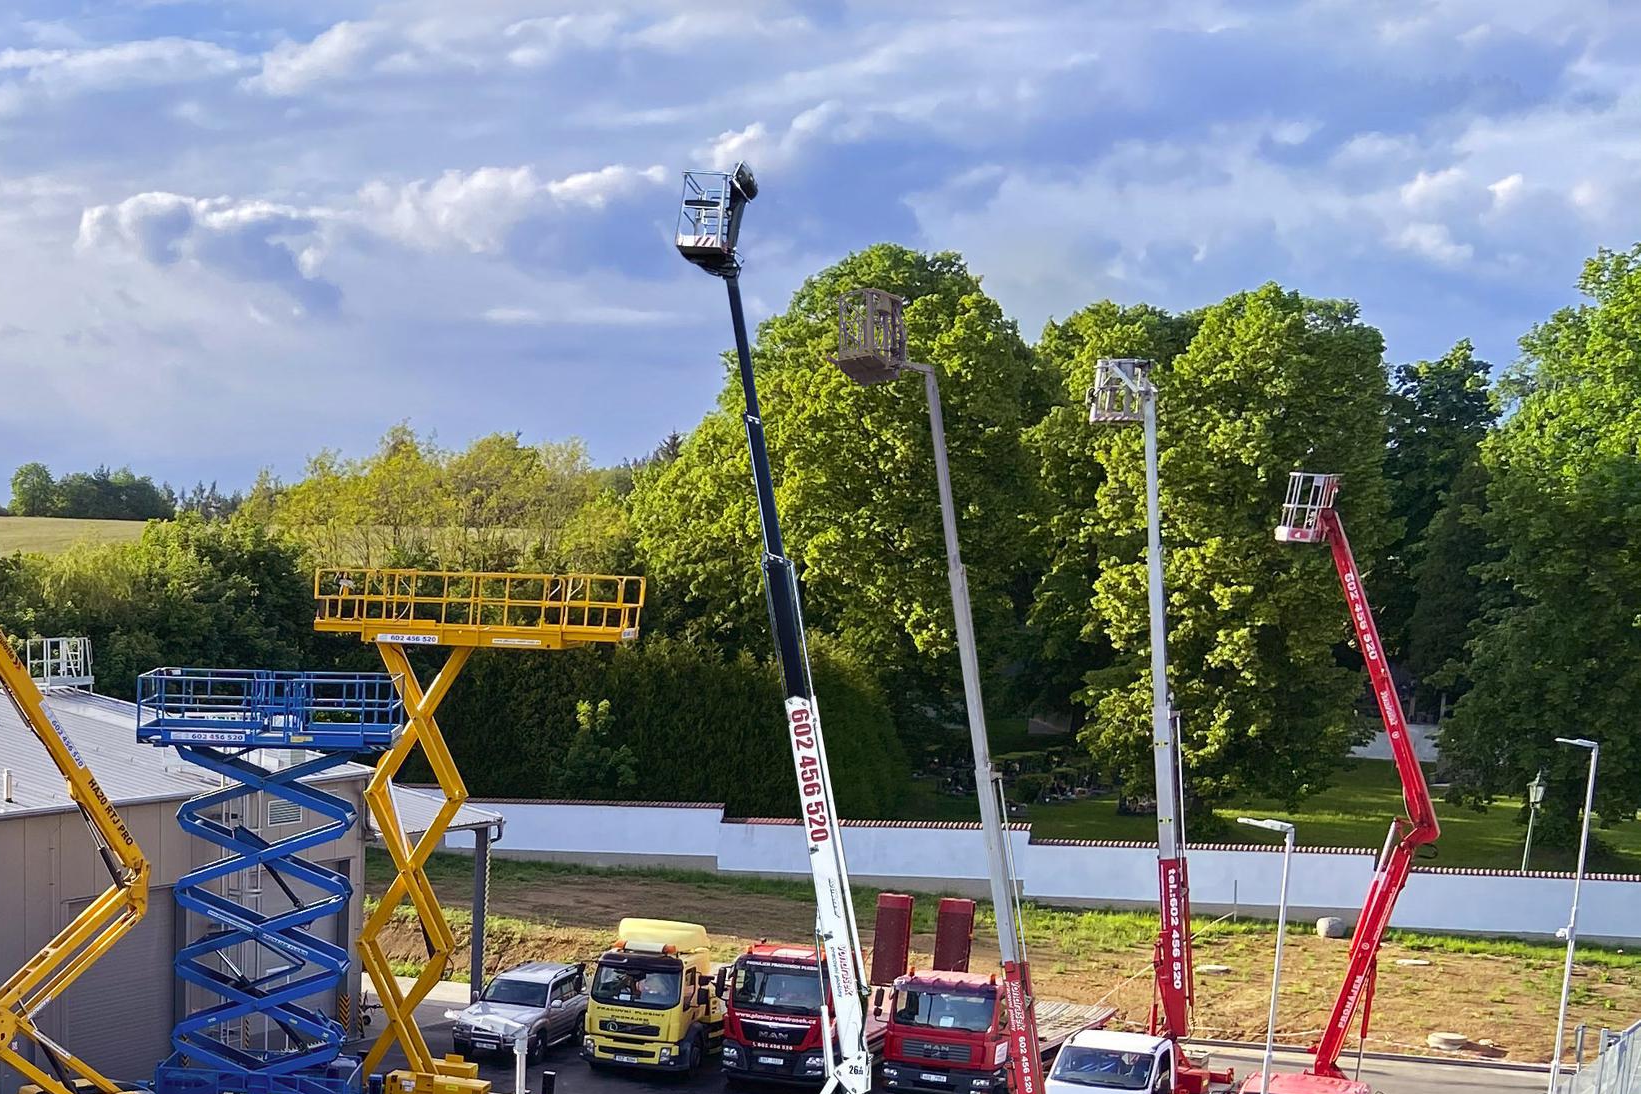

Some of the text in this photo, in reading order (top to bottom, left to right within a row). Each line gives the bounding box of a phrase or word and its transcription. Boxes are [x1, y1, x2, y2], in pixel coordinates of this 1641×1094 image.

[1344, 572, 1377, 660] 602 456 520
[51, 720, 84, 767] 602 456 520
[791, 708, 829, 842] 602 456 520
[88, 778, 133, 846] HA20 RTJ PRO
[1171, 929, 1181, 958] 456
[1173, 961, 1182, 989] 520
[759, 1031, 789, 1040] MAN
[923, 1044, 949, 1052] MAN
[1018, 1036, 1027, 1054] 602
[1021, 1056, 1030, 1074] 456
[1024, 1075, 1033, 1093] 520
